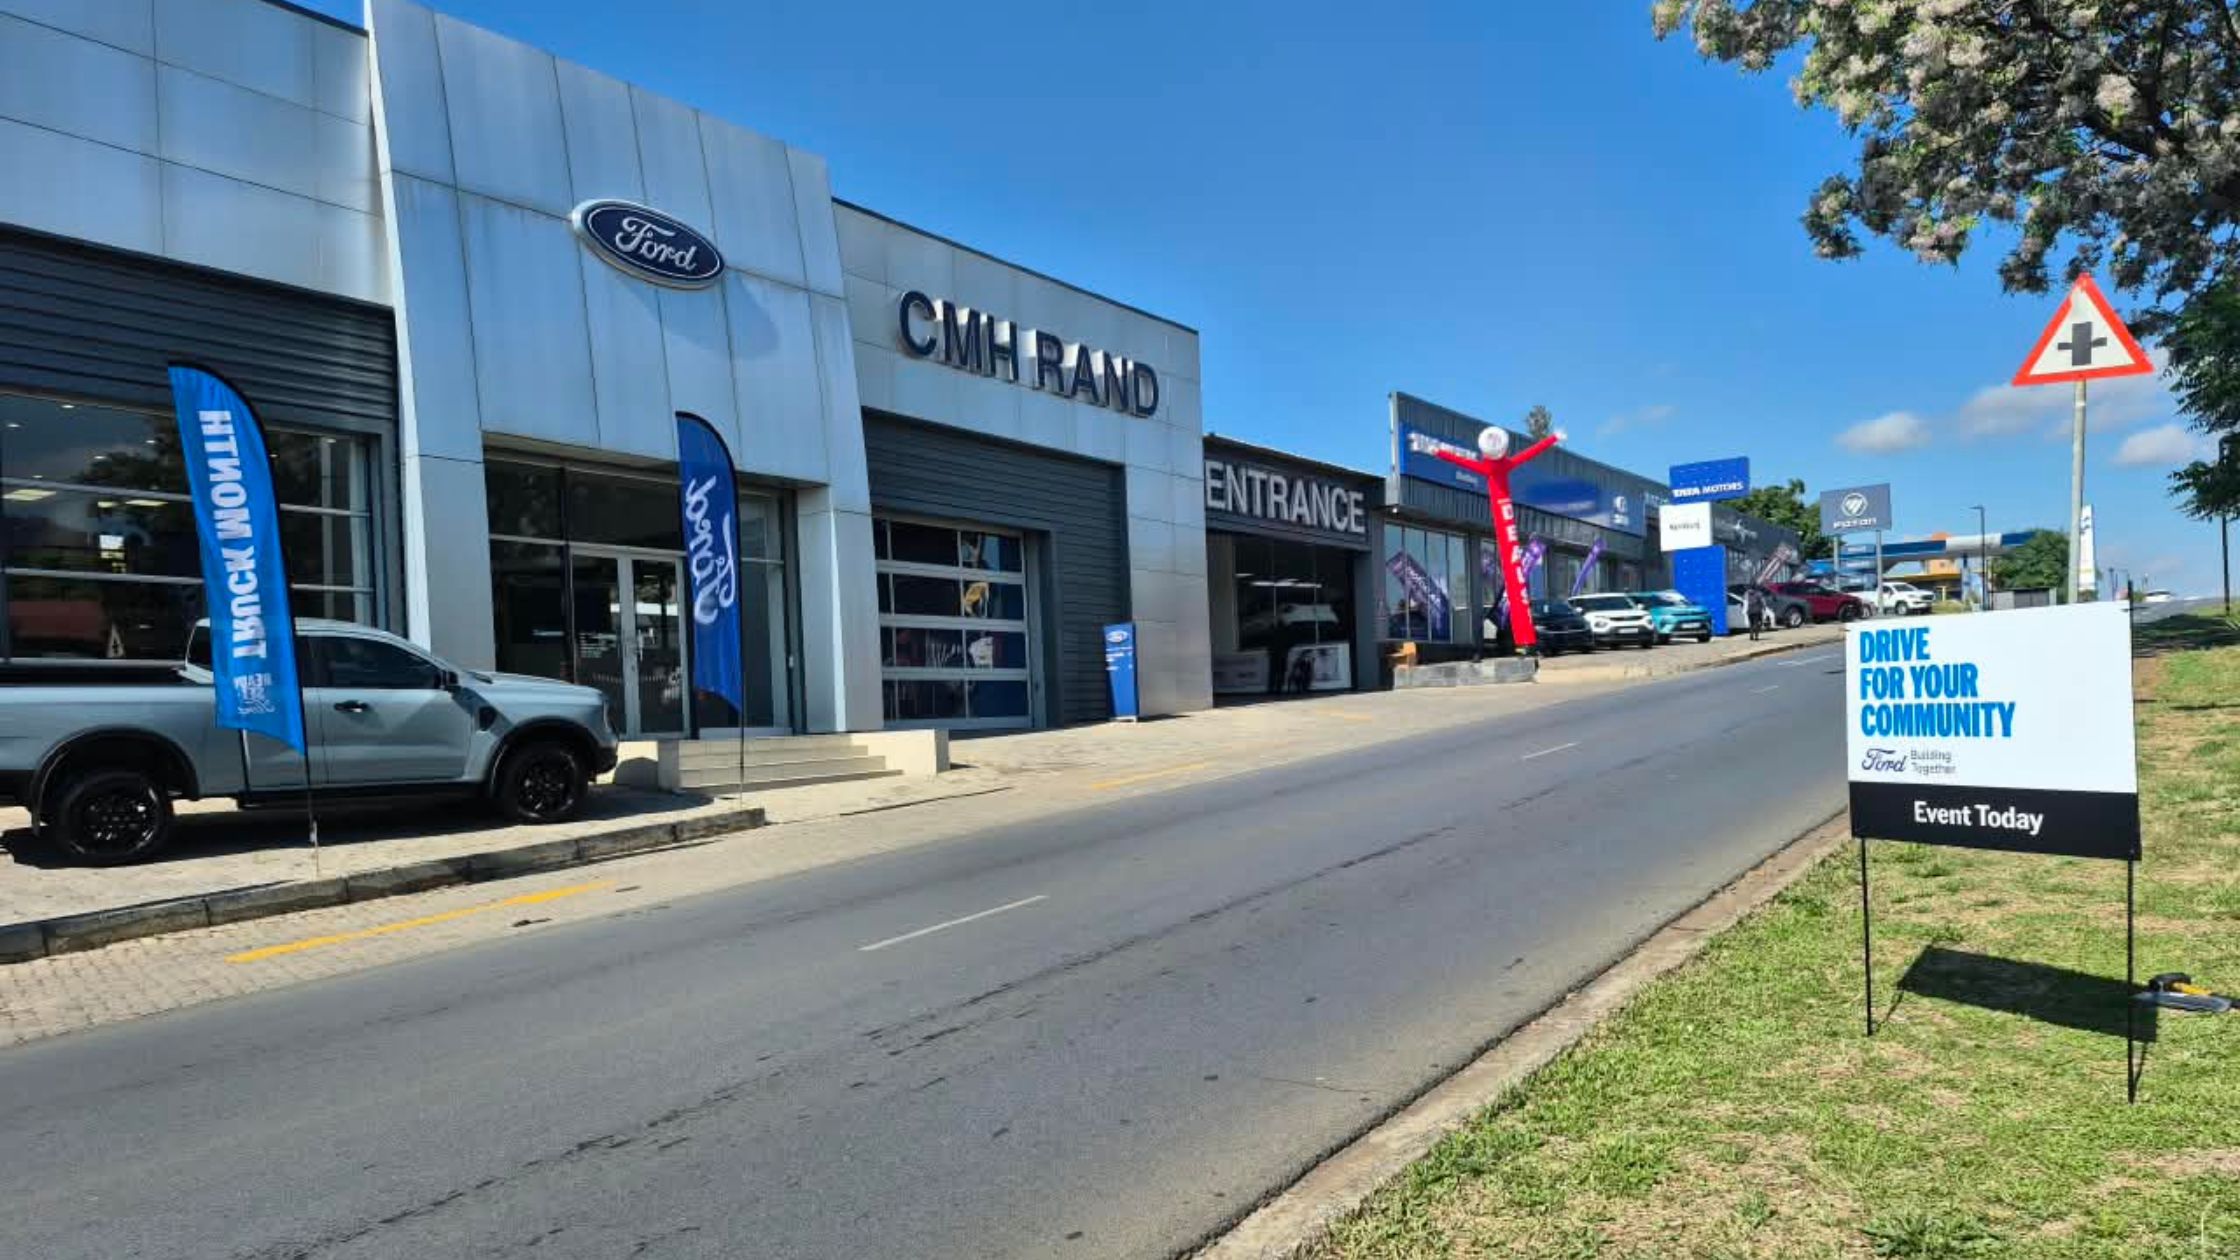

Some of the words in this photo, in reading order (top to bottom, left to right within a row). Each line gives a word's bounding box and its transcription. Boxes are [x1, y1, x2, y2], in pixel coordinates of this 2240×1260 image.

[615, 216, 697, 272] Ford
[899, 290, 1019, 381] CMH
[1034, 330, 1160, 417] RAND
[1204, 460, 1367, 535] ENTRANCE
[1672, 487, 1700, 498] TATA
[1702, 481, 1744, 493] MOTORS
[1860, 627, 1930, 663] DRIVE
[1860, 666, 1905, 700] FOR
[1909, 663, 1978, 699] YOUR
[1861, 701, 2015, 738] COMMUNITY
[1861, 748, 1907, 772] Ford
[1911, 749, 1952, 763] Building
[1911, 762, 1956, 775] Together
[1914, 801, 1972, 827] Event
[1974, 804, 2044, 836] Today
